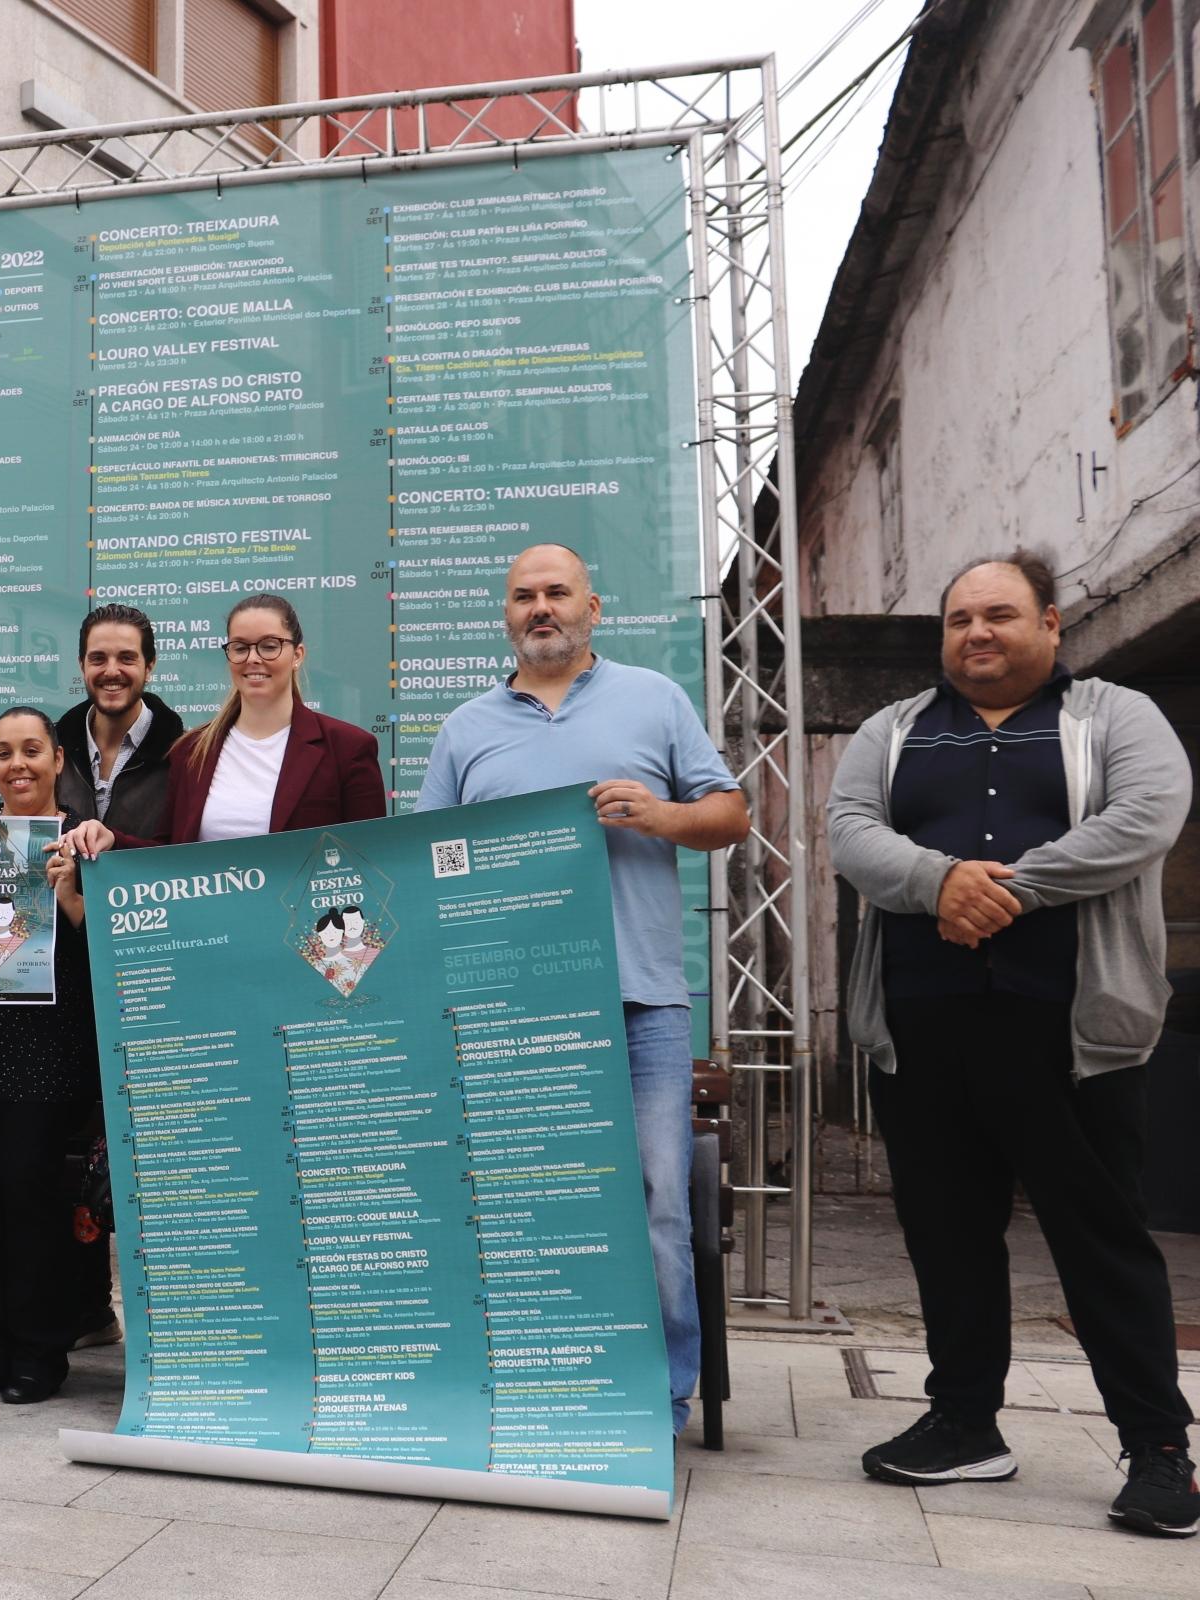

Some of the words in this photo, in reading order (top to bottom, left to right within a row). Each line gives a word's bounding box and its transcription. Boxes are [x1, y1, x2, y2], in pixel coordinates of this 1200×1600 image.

[100, 224, 182, 242] CONCERTO:
[186, 215, 279, 235] TREIXADURA
[1, 250, 44, 269] 2022
[5, 286, 43, 295] DEPORTE
[4, 304, 38, 312] OUTROS
[100, 307, 182, 325] CONCERTO:
[186, 303, 238, 318] COQUE
[242, 299, 293, 314] MALLA
[99, 346, 148, 361] LOURO
[152, 342, 206, 357] VALLEY
[210, 336, 279, 353] FESTIVAL
[99, 379, 158, 397] PREGÓN
[162, 377, 217, 392] FESTAS
[221, 375, 242, 388] DO
[246, 371, 301, 387] CRISTO
[98, 402, 107, 413] A
[111, 398, 163, 413] CARGO
[167, 396, 186, 409] DE
[190, 391, 260, 407] ALFONSO
[264, 388, 302, 402] PATO
[184, 409, 206, 417] Praza
[209, 407, 251, 416] Arquitecto
[253, 404, 286, 413] Antonio
[288, 402, 324, 411] Palacios
[98, 431, 145, 442] ANIMACIÓN
[147, 432, 159, 440] DE
[161, 430, 180, 439] RÚA
[397, 425, 438, 434] BATALLA
[440, 424, 453, 432] DE
[455, 423, 488, 431] GALOS
[399, 488, 489, 505] CONCERTO:
[494, 481, 619, 500] TANXUGUEIRAS
[399, 527, 427, 536] FESTA
[429, 525, 482, 534] REMEMBER
[485, 523, 518, 532] (RADIO
[520, 523, 529, 531] 8)
[97, 535, 178, 551] MONTANDO
[182, 532, 237, 546] CRISTO
[241, 528, 311, 543] FESTIVAL
[97, 583, 181, 598] CONCERTO:
[185, 580, 239, 594] GISELA
[243, 577, 316, 592] CONCERT
[320, 575, 356, 589] KIDS
[400, 657, 498, 671] ORQUESTRA
[400, 675, 499, 689] ORQUESTRA
[473, 841, 530, 854] www.ecultura.net
[531, 839, 545, 848] para
[547, 835, 576, 845] consultar
[108, 885, 129, 908] O
[134, 867, 266, 904] PORRIÑO
[311, 874, 362, 891] FESTAS
[311, 891, 364, 909] CRISTO
[111, 908, 168, 935] 2022
[115, 933, 229, 956] www.ecultura.net
[444, 948, 526, 968] SETEMBRO
[530, 938, 601, 958] CULTURA
[446, 966, 519, 986] OUTUBRO
[532, 957, 604, 977] CULTURA
[461, 1037, 515, 1051] ORQUESTRA
[517, 1036, 528, 1046] LA
[530, 1030, 580, 1044] DIMENSIÓN
[462, 1048, 516, 1061] ORQUESTRA
[518, 1045, 551, 1056] COMBO
[554, 1039, 611, 1053] DOMINICANO
[307, 1214, 355, 1224] CONCERTO:
[357, 1212, 387, 1222] COQUE
[389, 1210, 419, 1220] MALLA
[484, 1248, 536, 1260] CONCERTO:
[538, 1245, 608, 1257] TANXUGUEIRAS
[318, 1345, 365, 1355] MONTANDO
[367, 1344, 398, 1353] CRISTO
[400, 1343, 441, 1352] FESTIVAL
[494, 1347, 548, 1357] ORQUESTRA
[551, 1344, 591, 1355] AMÉRICA
[593, 1345, 606, 1353] SL
[319, 1373, 349, 1382] GISELA
[351, 1372, 392, 1381] CONCERT
[394, 1372, 414, 1380] KIDS
[319, 1404, 371, 1413] ORQUESTRA
[373, 1403, 407, 1412] ATENAS
[540, 1463, 557, 1471] TES
[560, 1463, 608, 1471] TALENTO?
